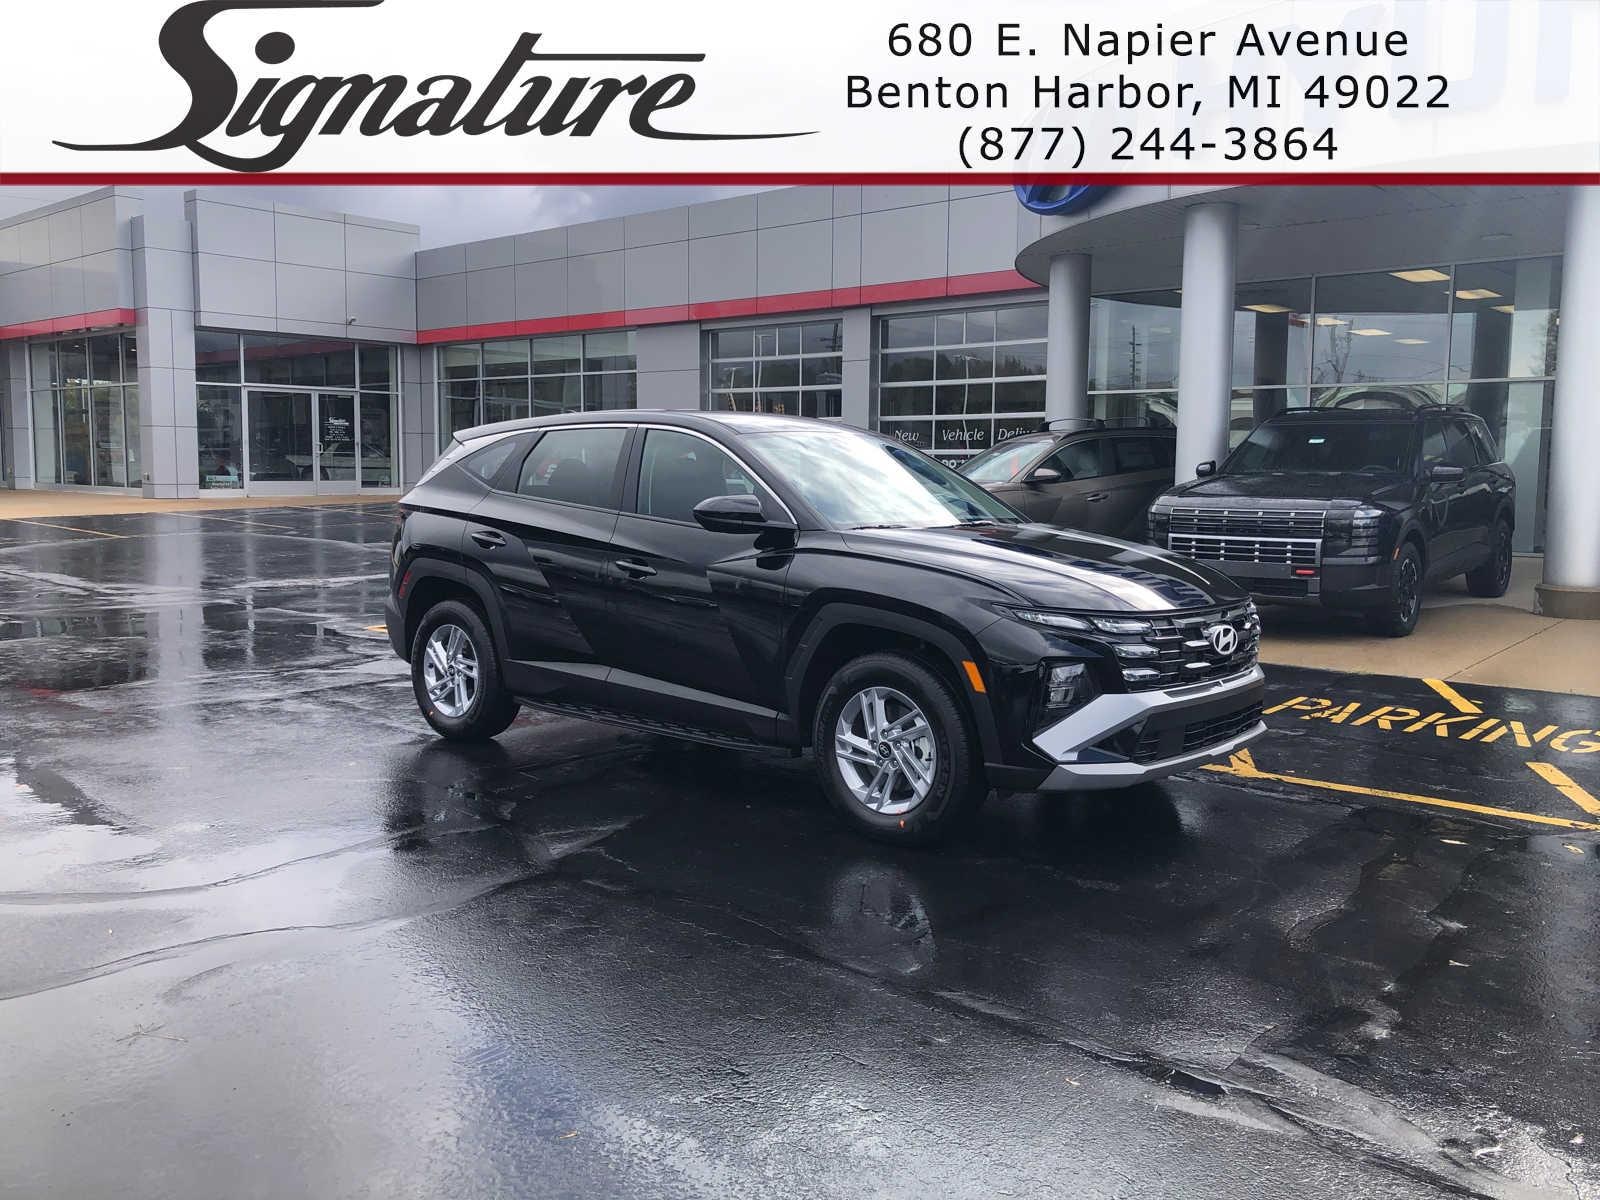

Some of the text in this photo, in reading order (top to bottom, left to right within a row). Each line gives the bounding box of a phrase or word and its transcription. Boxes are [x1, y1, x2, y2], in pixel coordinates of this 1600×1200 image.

[894, 430, 920, 441] New
[942, 428, 985, 441] Vehicle
[1262, 696, 1600, 753] PARKING
